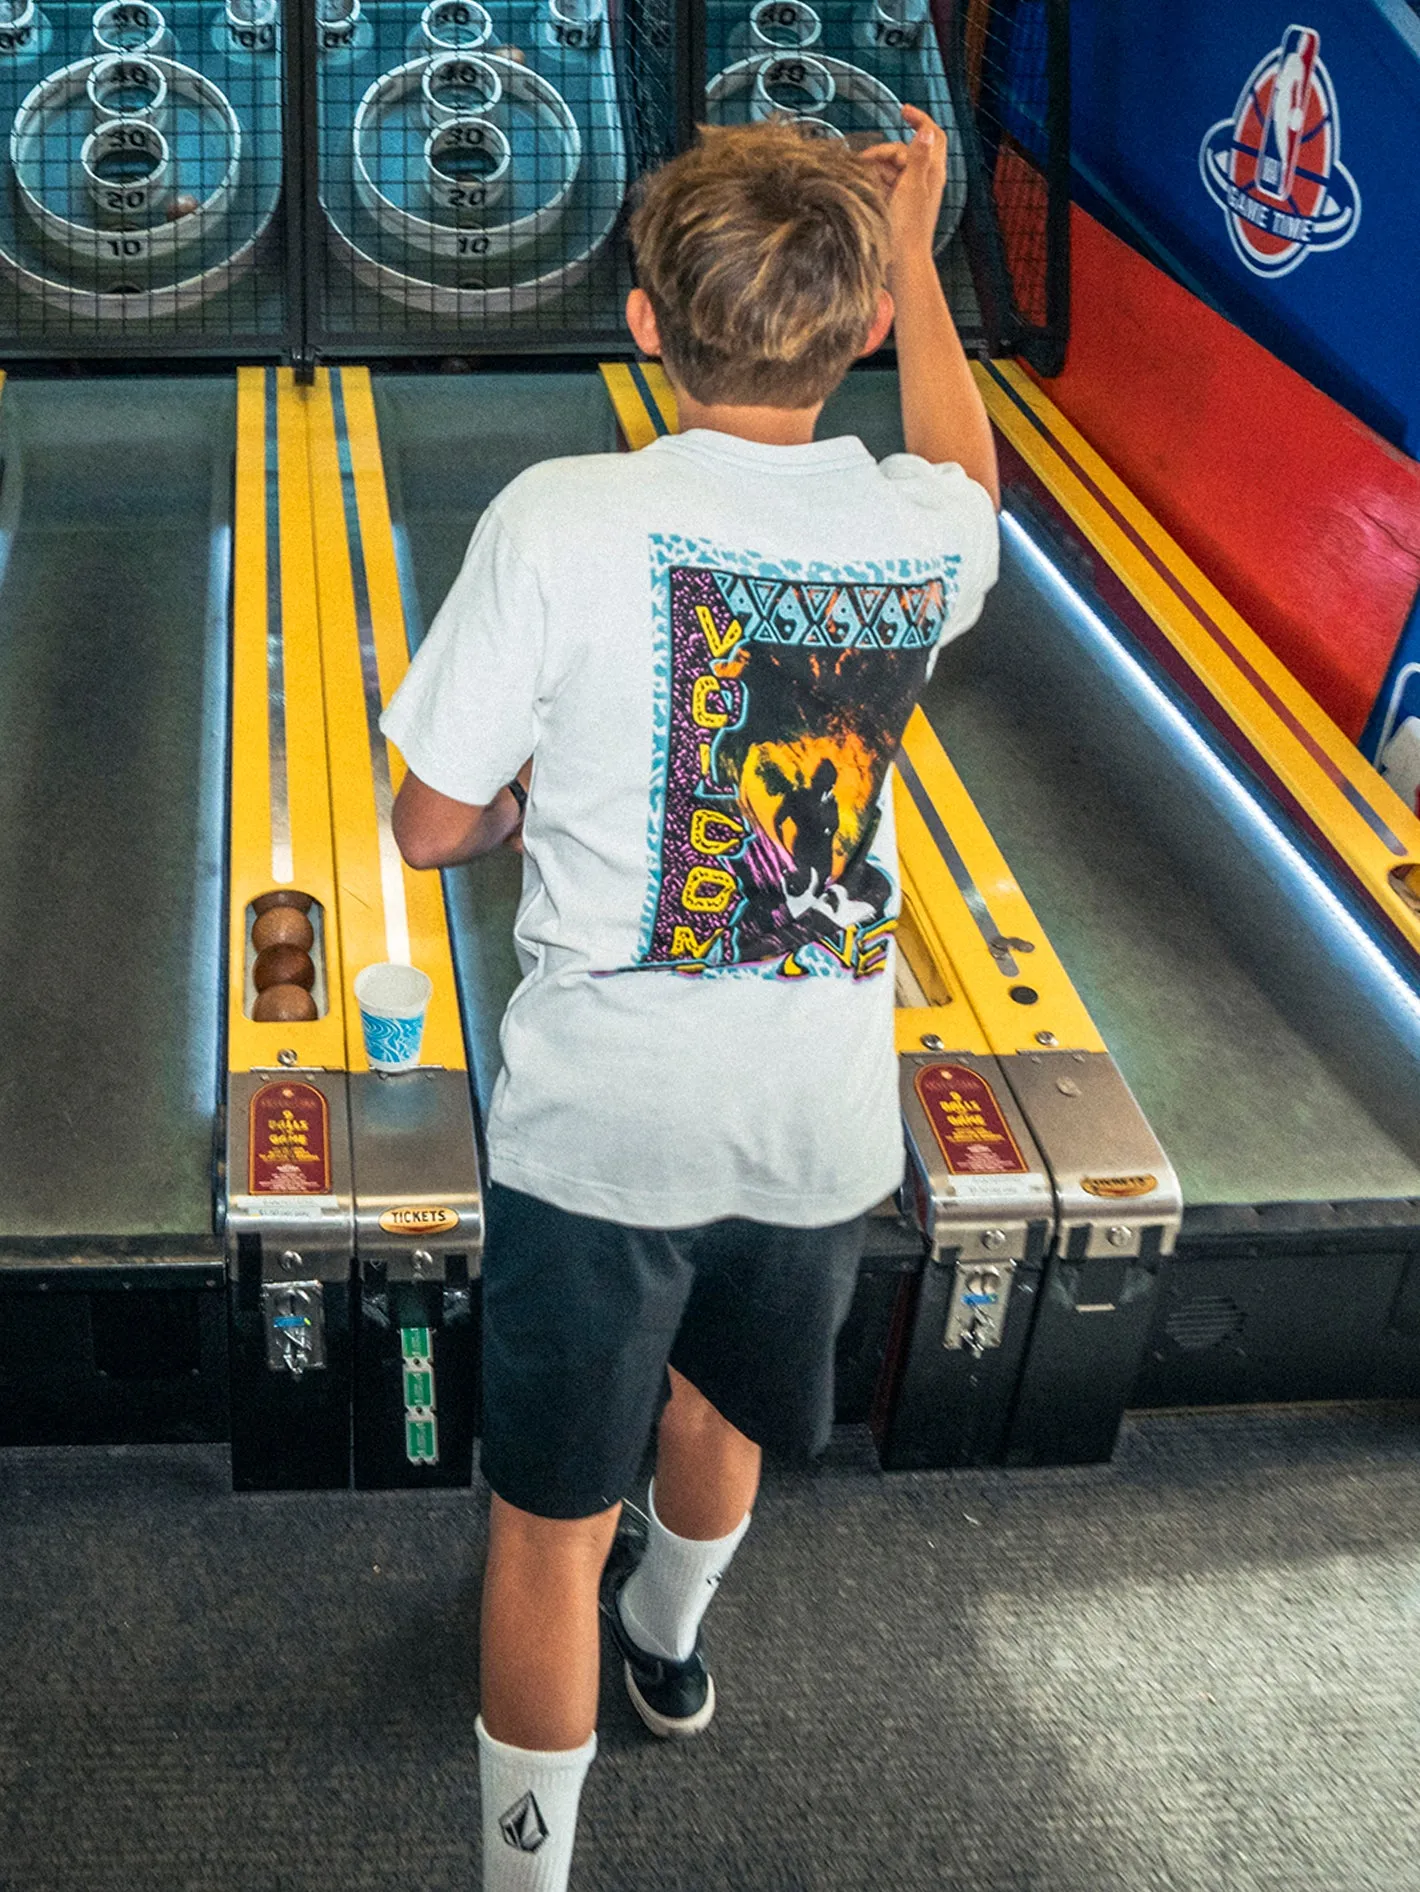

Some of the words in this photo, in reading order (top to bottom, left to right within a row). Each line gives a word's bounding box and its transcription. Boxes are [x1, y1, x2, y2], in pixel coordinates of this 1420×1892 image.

[108, 130, 147, 147] 30
[445, 127, 484, 147] 30
[105, 190, 145, 208] 20
[448, 189, 486, 207] 20
[1227, 183, 1269, 229] GAME
[1272, 209, 1313, 242] TIME
[106, 239, 142, 256] 10
[456, 237, 490, 255] 10
[391, 1209, 447, 1223] TICKETS
